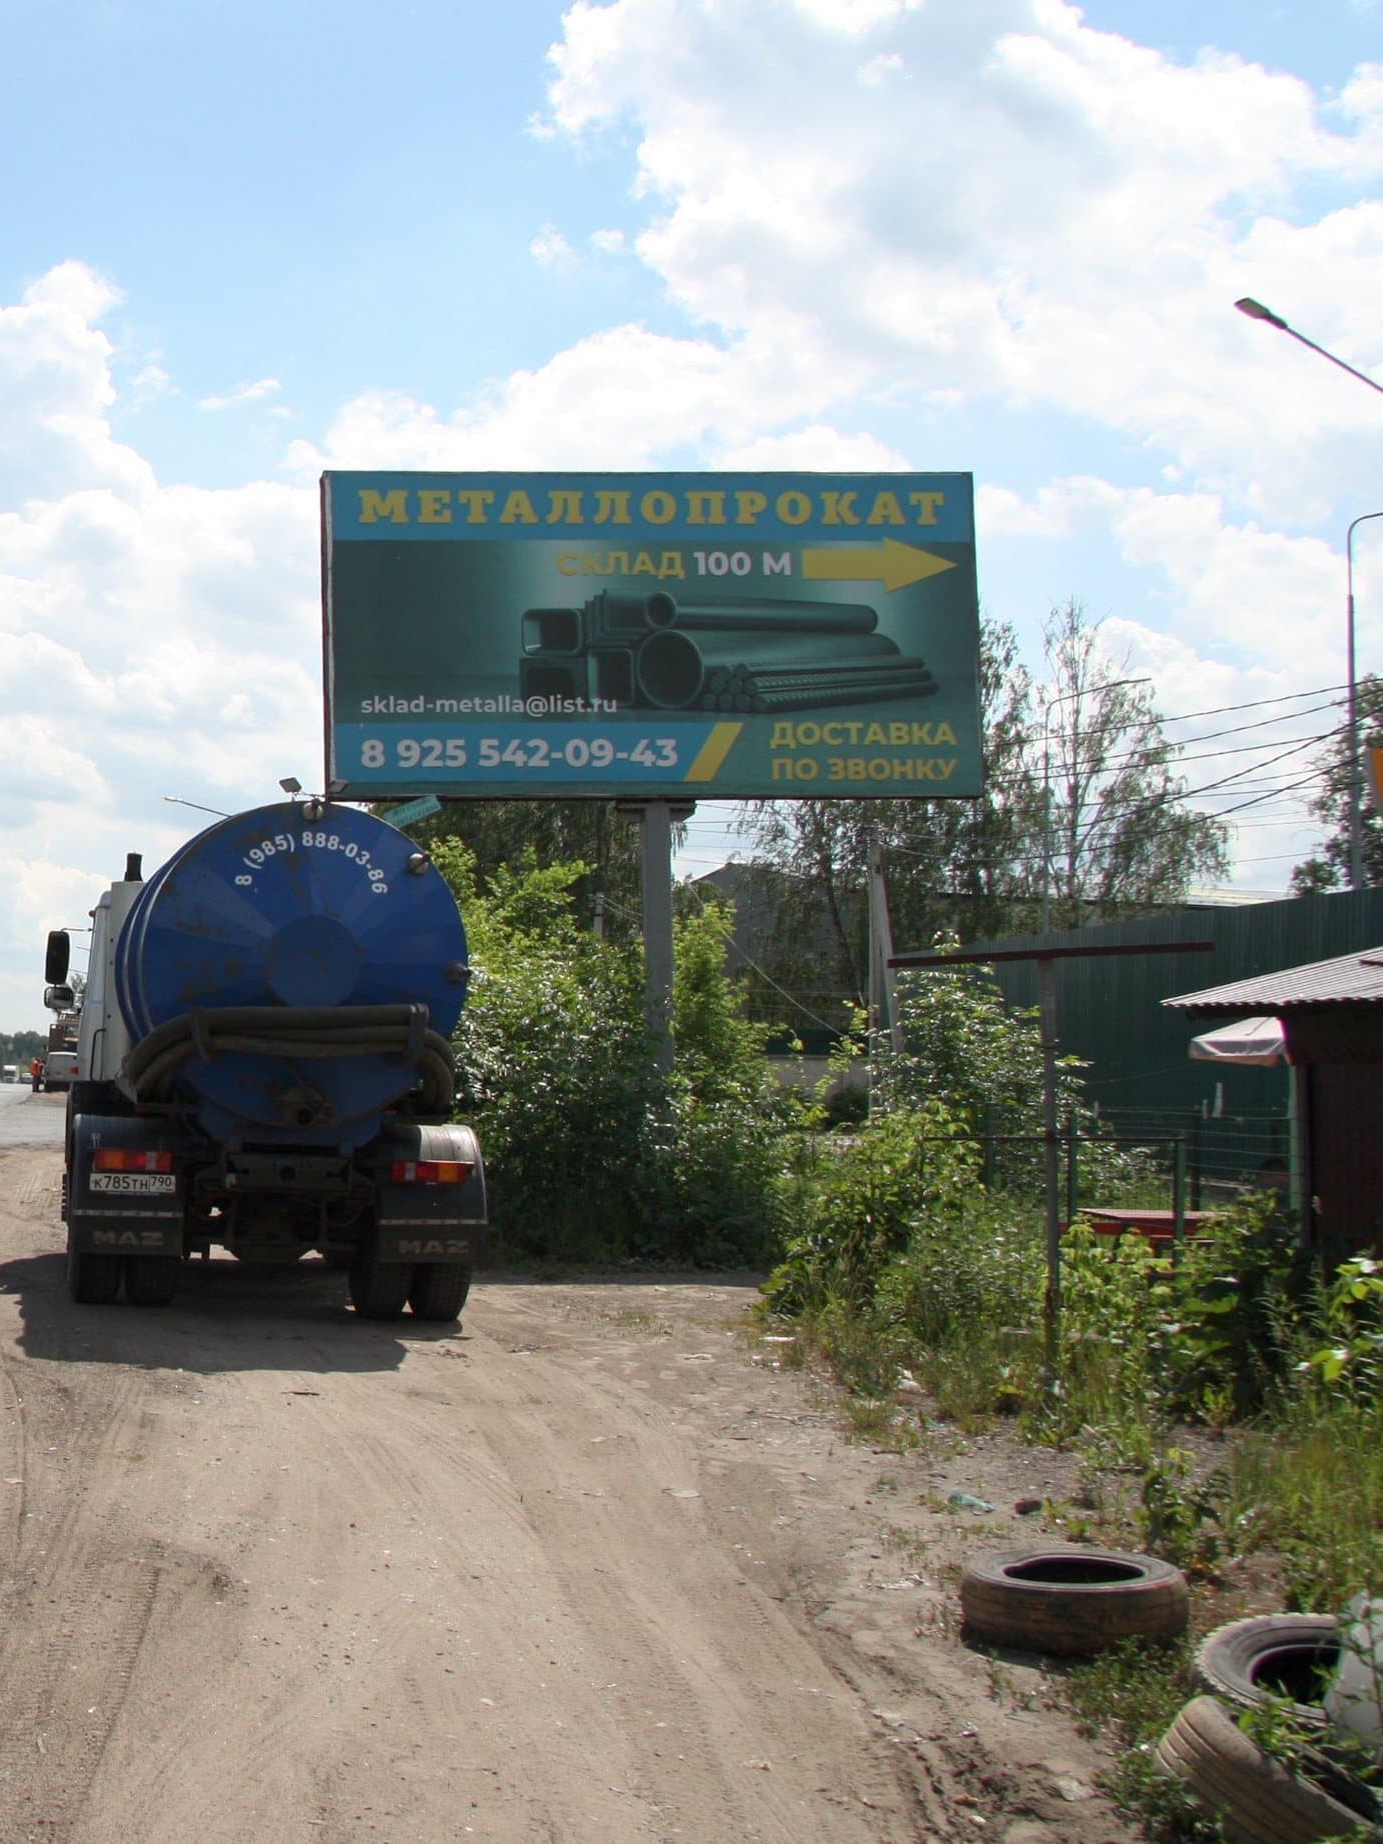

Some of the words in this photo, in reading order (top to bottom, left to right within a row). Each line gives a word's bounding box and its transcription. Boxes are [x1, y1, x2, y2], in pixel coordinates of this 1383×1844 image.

[358, 489, 945, 525] МЕТАЛЛОПРОКАТ
[555, 551, 685, 579] СКЛАД
[693, 551, 752, 576] 100
[763, 551, 792, 576] М
[360, 695, 618, 717] sklad-metalla@list.ru
[770, 722, 958, 749] ДОСТАВКА
[360, 738, 385, 768] 8
[397, 738, 467, 768] 925
[478, 738, 679, 768] 542-09-43
[771, 757, 819, 781] ПО
[827, 757, 959, 781] ЗВОНКУ
[243, 833, 295, 870] (985)
[302, 831, 388, 894] 888-03-86
[234, 874, 253, 886] 8
[152, 1176, 172, 1188] 790
